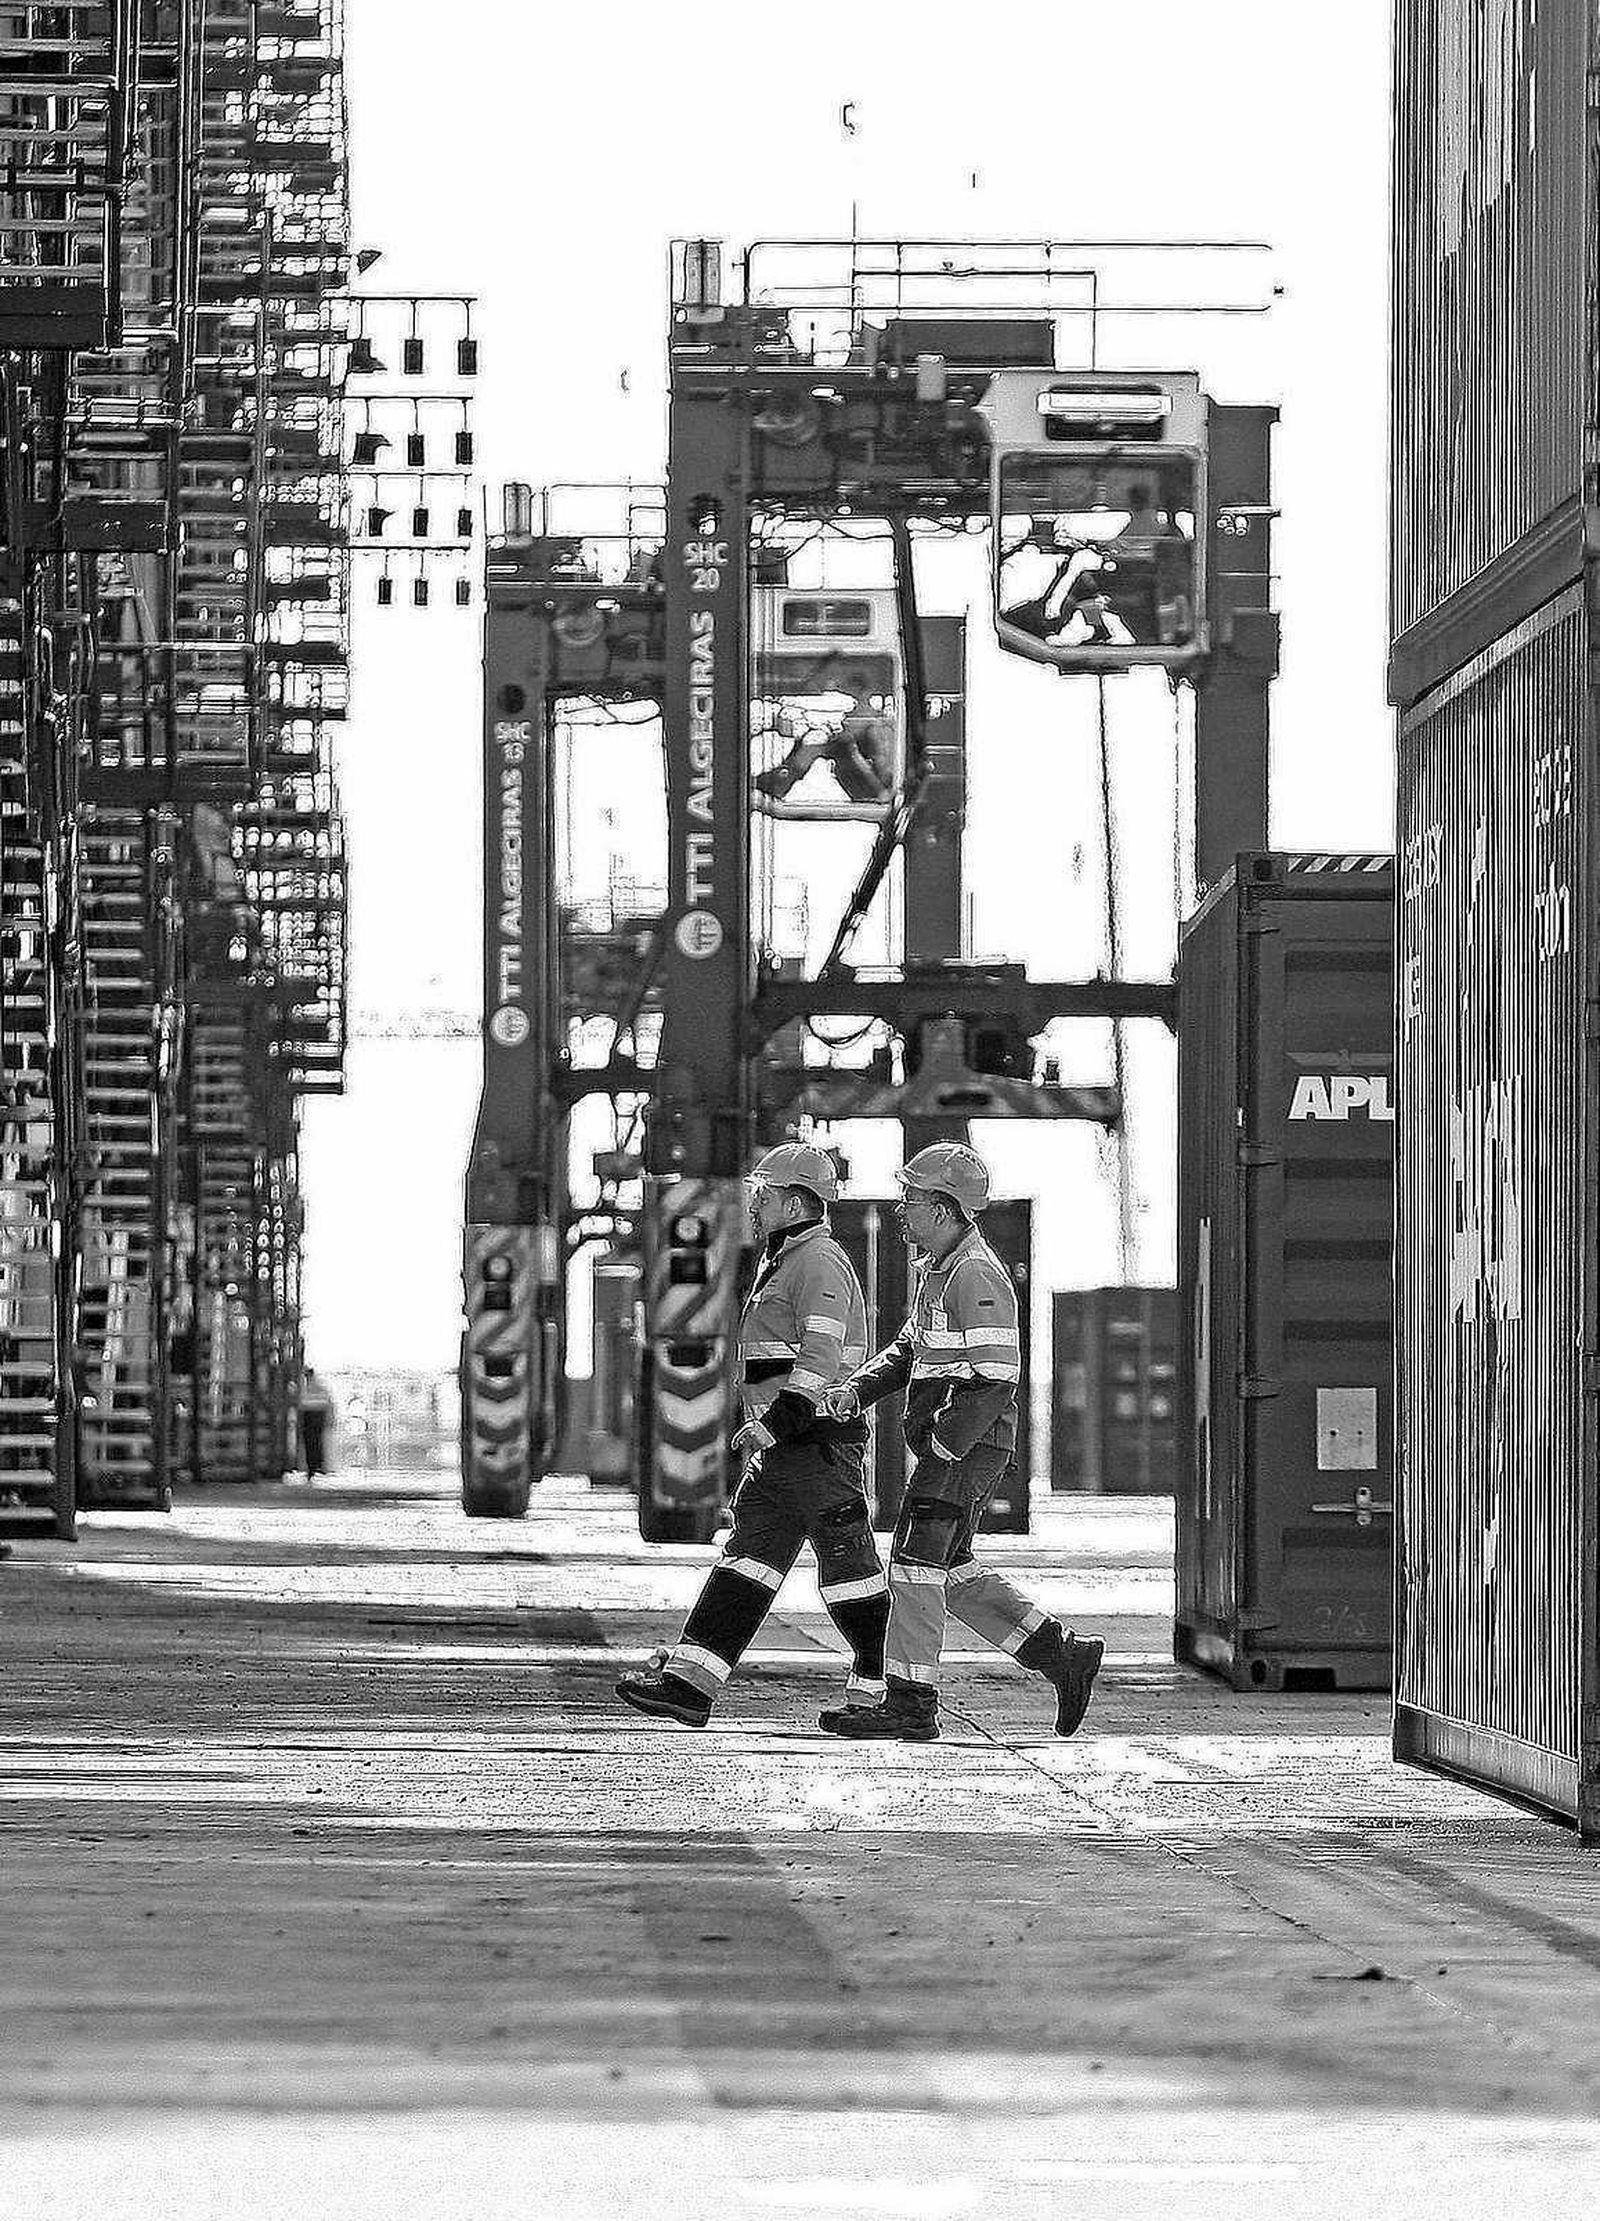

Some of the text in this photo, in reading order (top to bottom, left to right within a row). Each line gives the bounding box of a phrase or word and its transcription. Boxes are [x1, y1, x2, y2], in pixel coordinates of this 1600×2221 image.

[683, 541, 729, 567] SHC
[690, 567, 720, 592] 20
[685, 610, 716, 822] ALGECIRAS
[498, 768, 524, 937] ALGECIRAS
[685, 832, 715, 906] TTI
[498, 944, 523, 1004] TTI
[1287, 1076, 1395, 1121] APL
